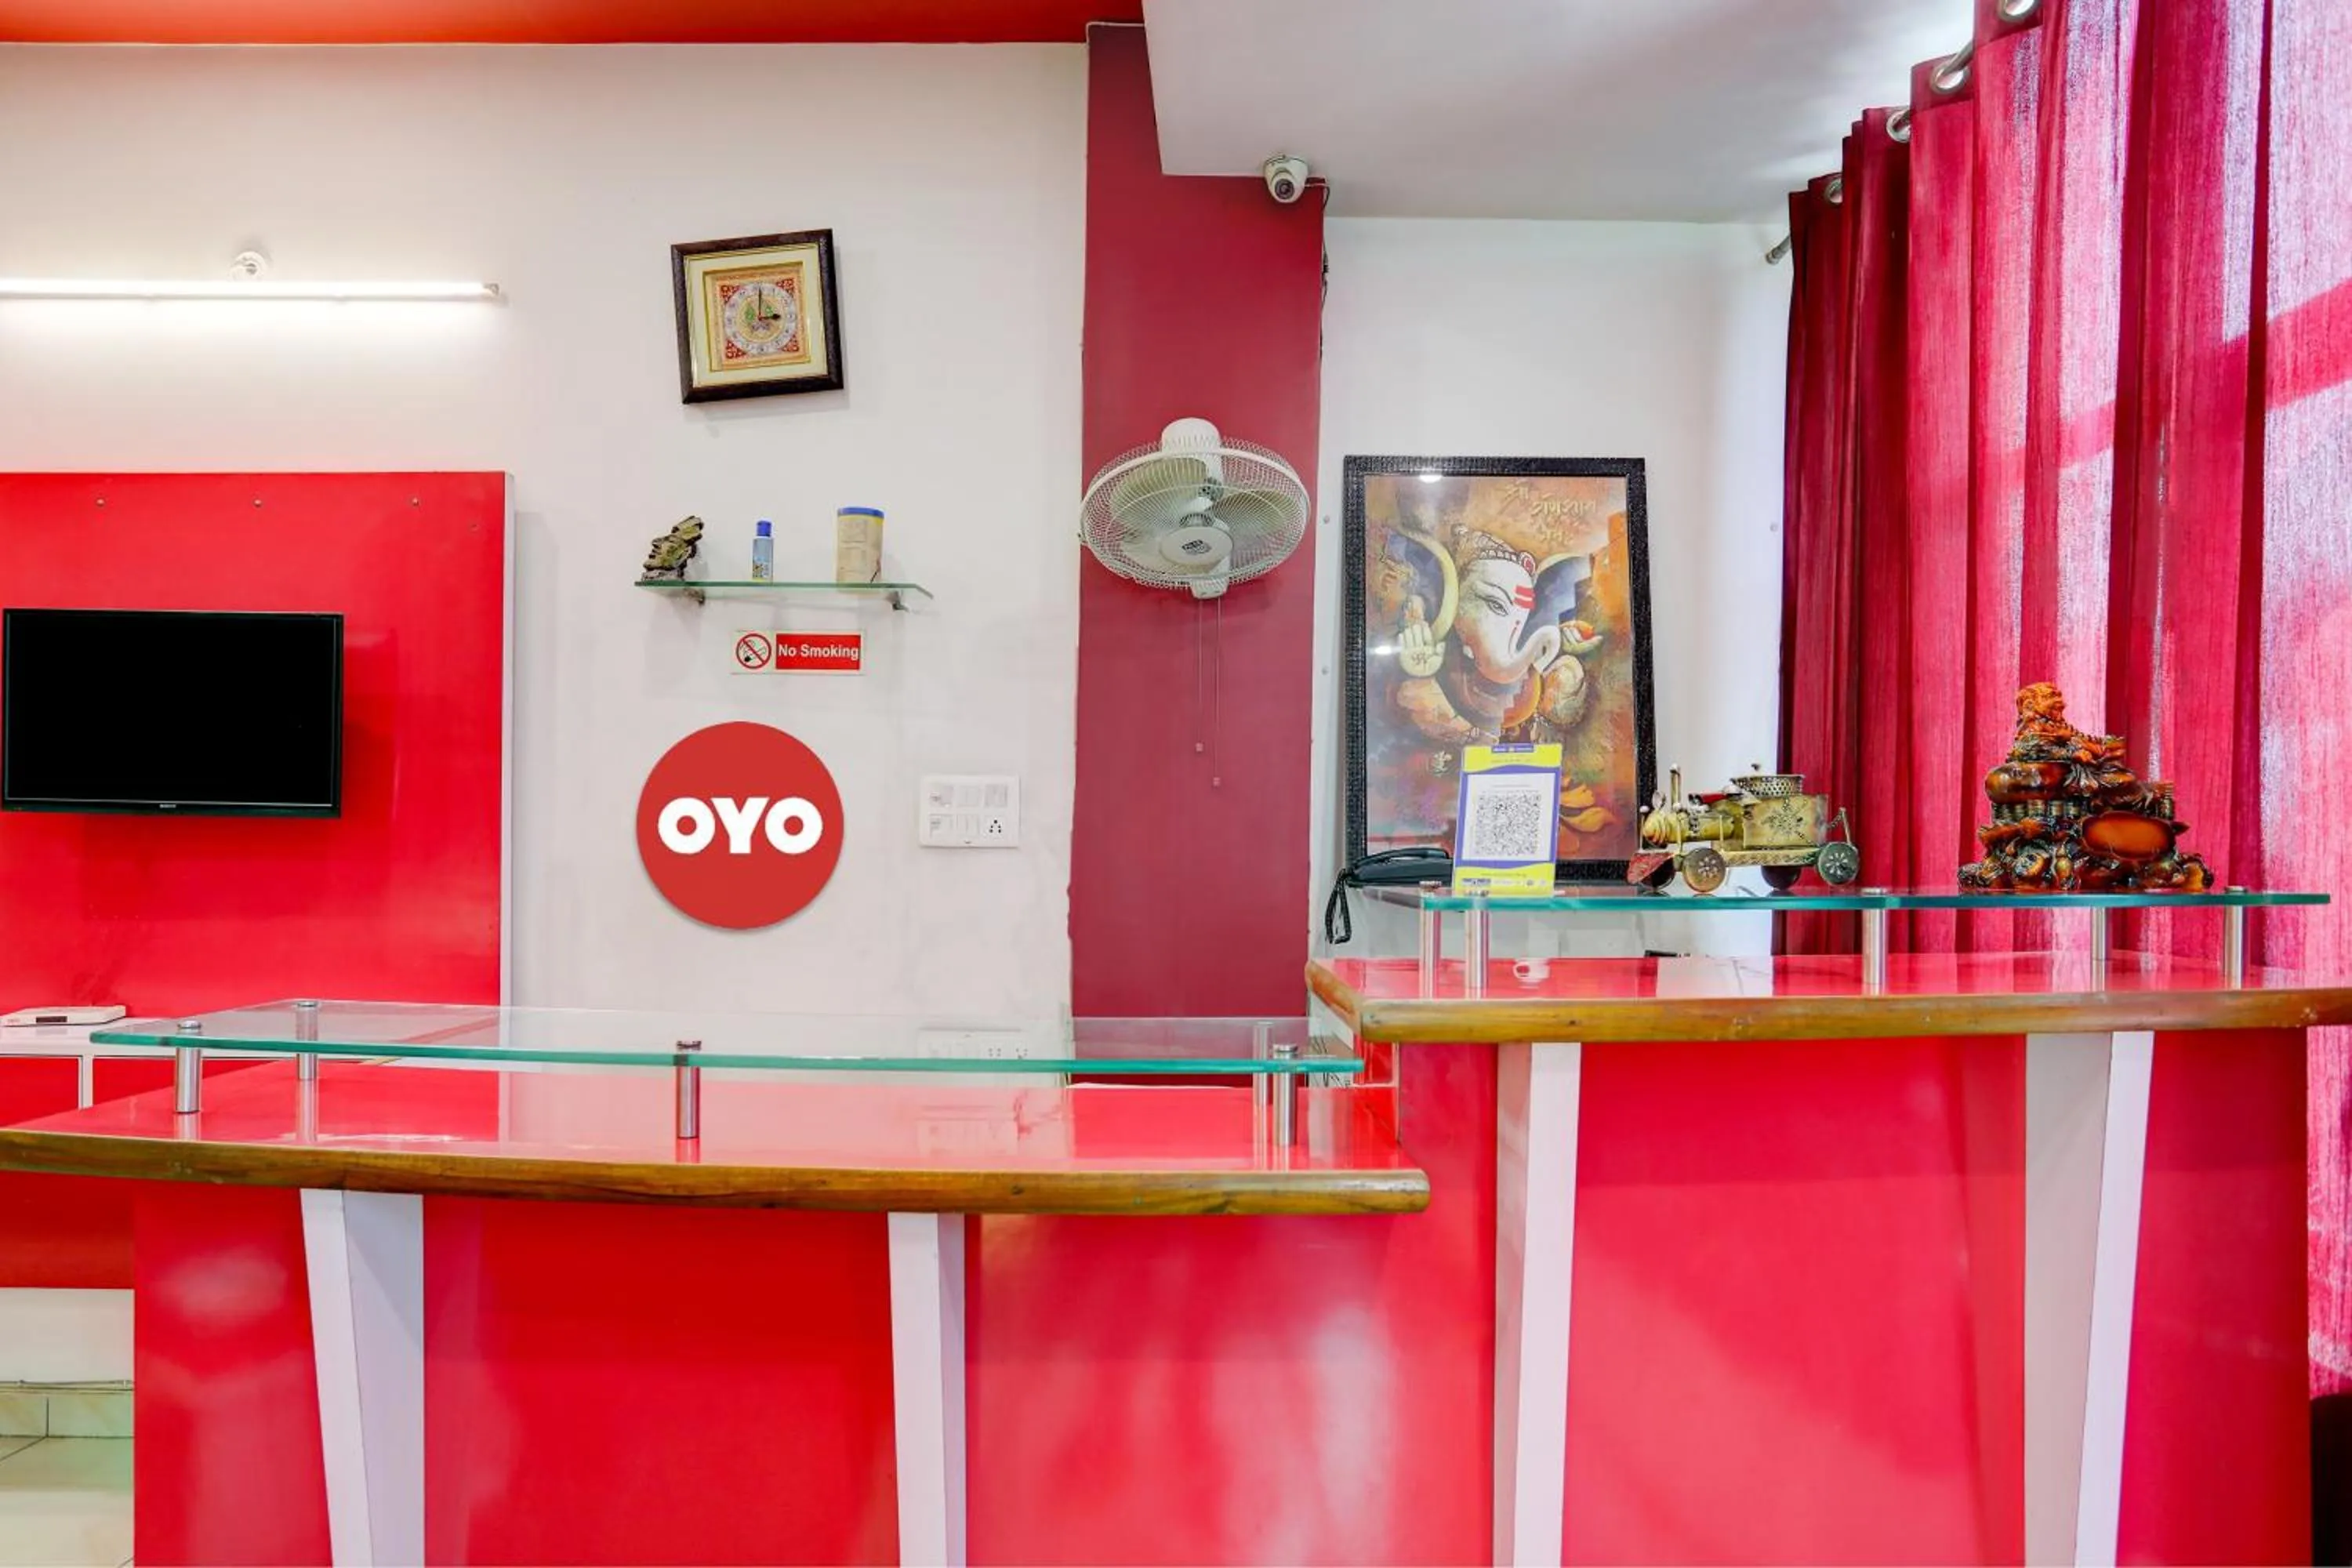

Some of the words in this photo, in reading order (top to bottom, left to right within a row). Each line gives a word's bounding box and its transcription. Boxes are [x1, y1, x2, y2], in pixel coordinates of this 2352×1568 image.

[779, 644, 797, 657] No
[800, 644, 859, 661] Smoking
[658, 797, 823, 854] OYO
